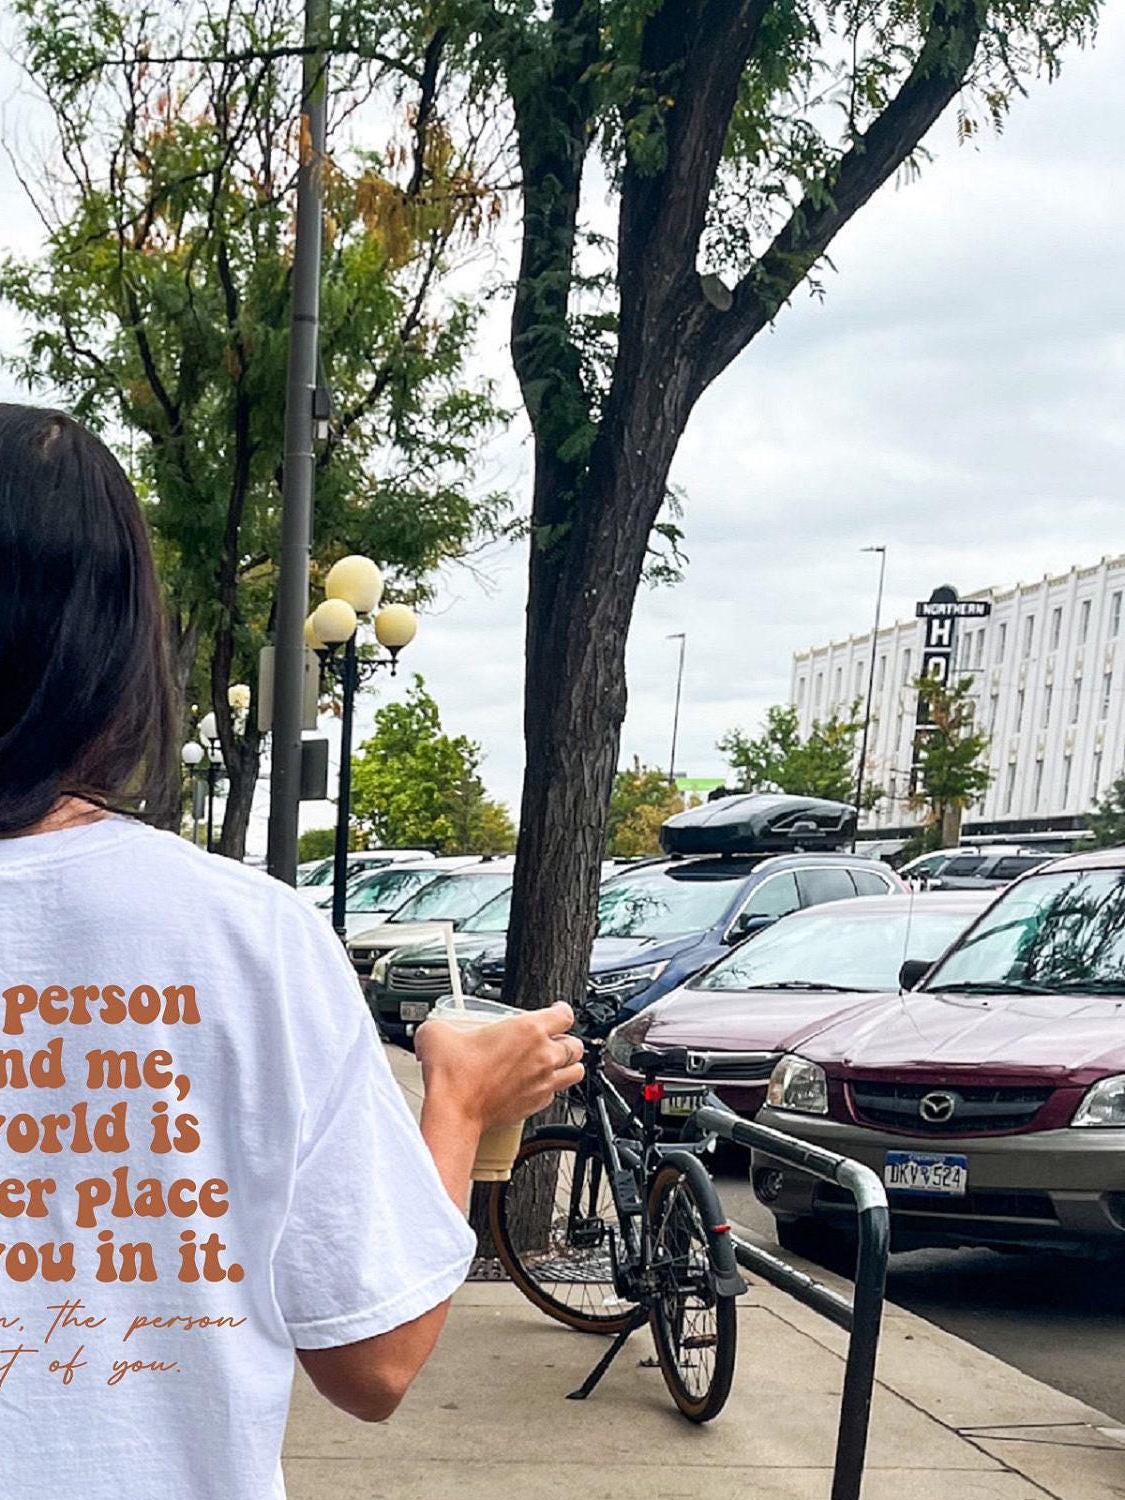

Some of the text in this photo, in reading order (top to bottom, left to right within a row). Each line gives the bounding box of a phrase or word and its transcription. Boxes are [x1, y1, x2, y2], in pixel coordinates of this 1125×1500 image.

[922, 603, 985, 615] NORTHERN
[2, 984, 201, 1035] person
[85, 1049, 191, 1102] me,
[150, 1101, 201, 1154] is
[75, 1165, 229, 1229] place
[95, 1229, 158, 1284] in
[177, 1229, 245, 1284] it.
[122, 1314, 248, 1342] person
[48, 1345, 88, 1386] of
[106, 1358, 183, 1386] you.
